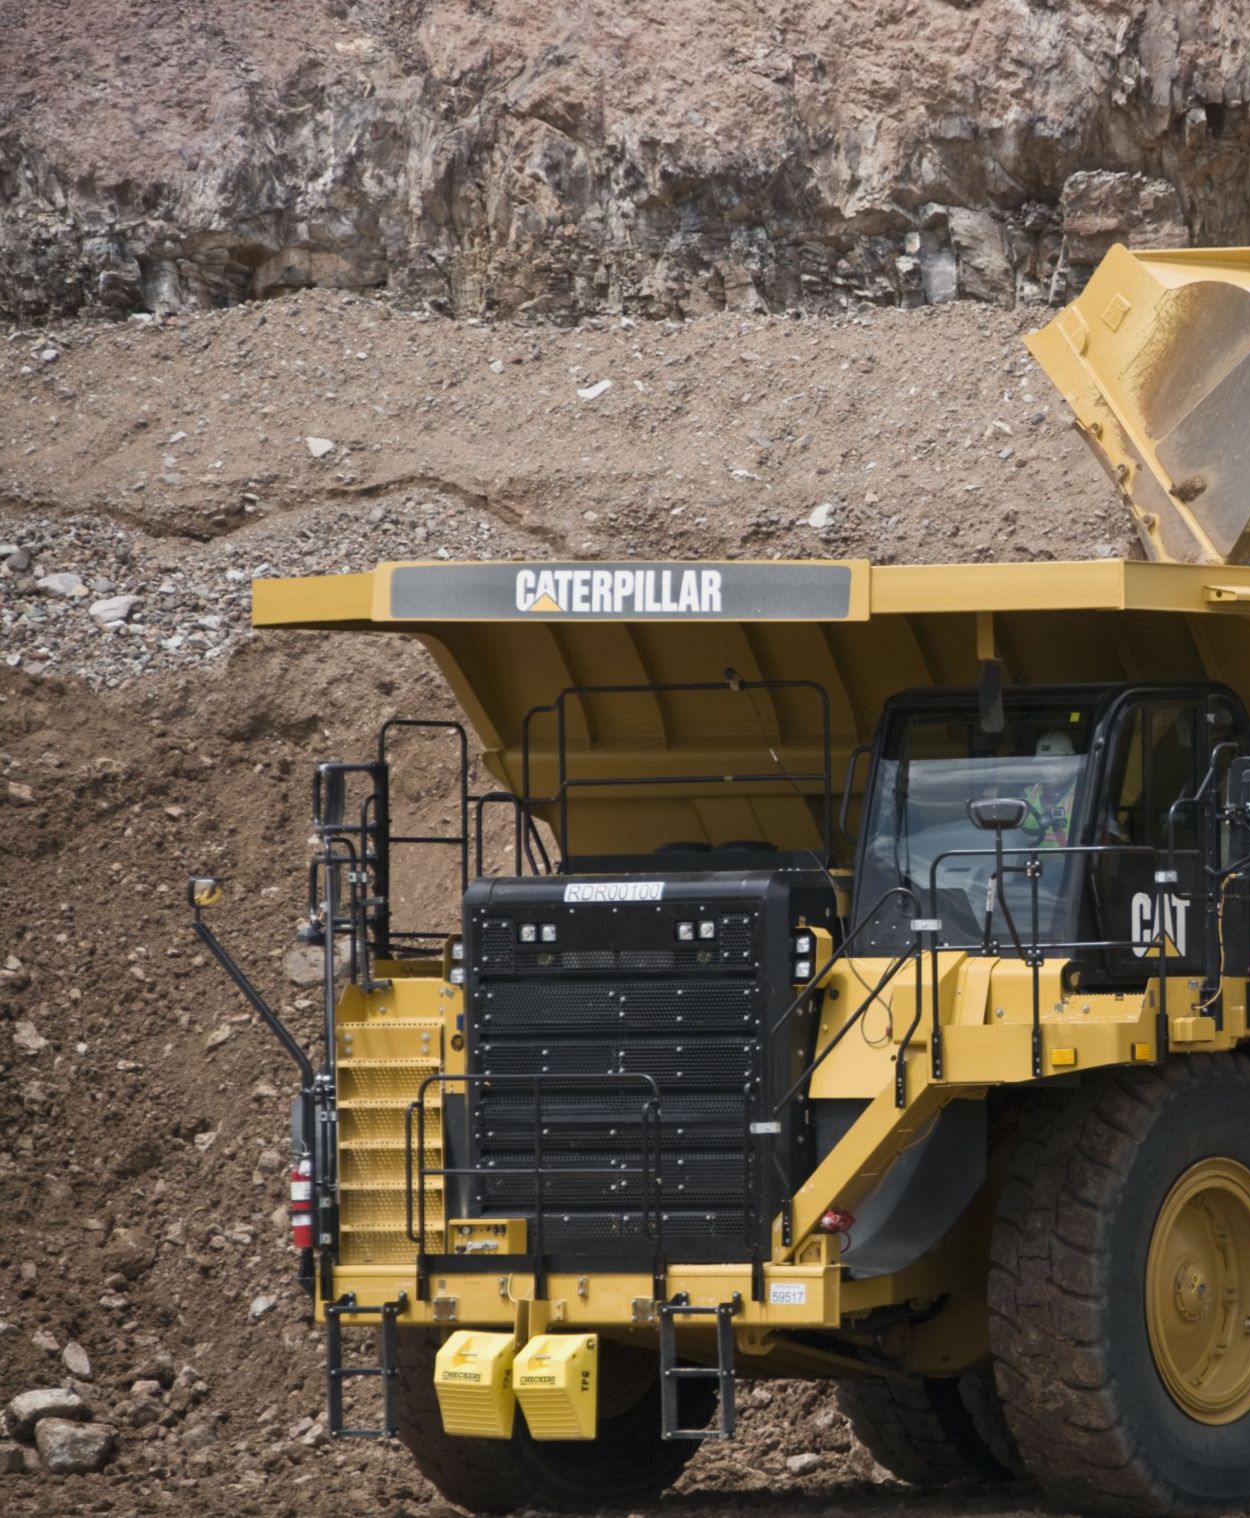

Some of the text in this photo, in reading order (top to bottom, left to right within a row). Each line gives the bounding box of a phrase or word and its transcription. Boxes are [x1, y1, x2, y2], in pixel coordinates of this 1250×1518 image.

[515, 569, 723, 613] CATERPILLAR
[567, 884, 660, 901] RDR00100
[1131, 892, 1191, 958] CAT
